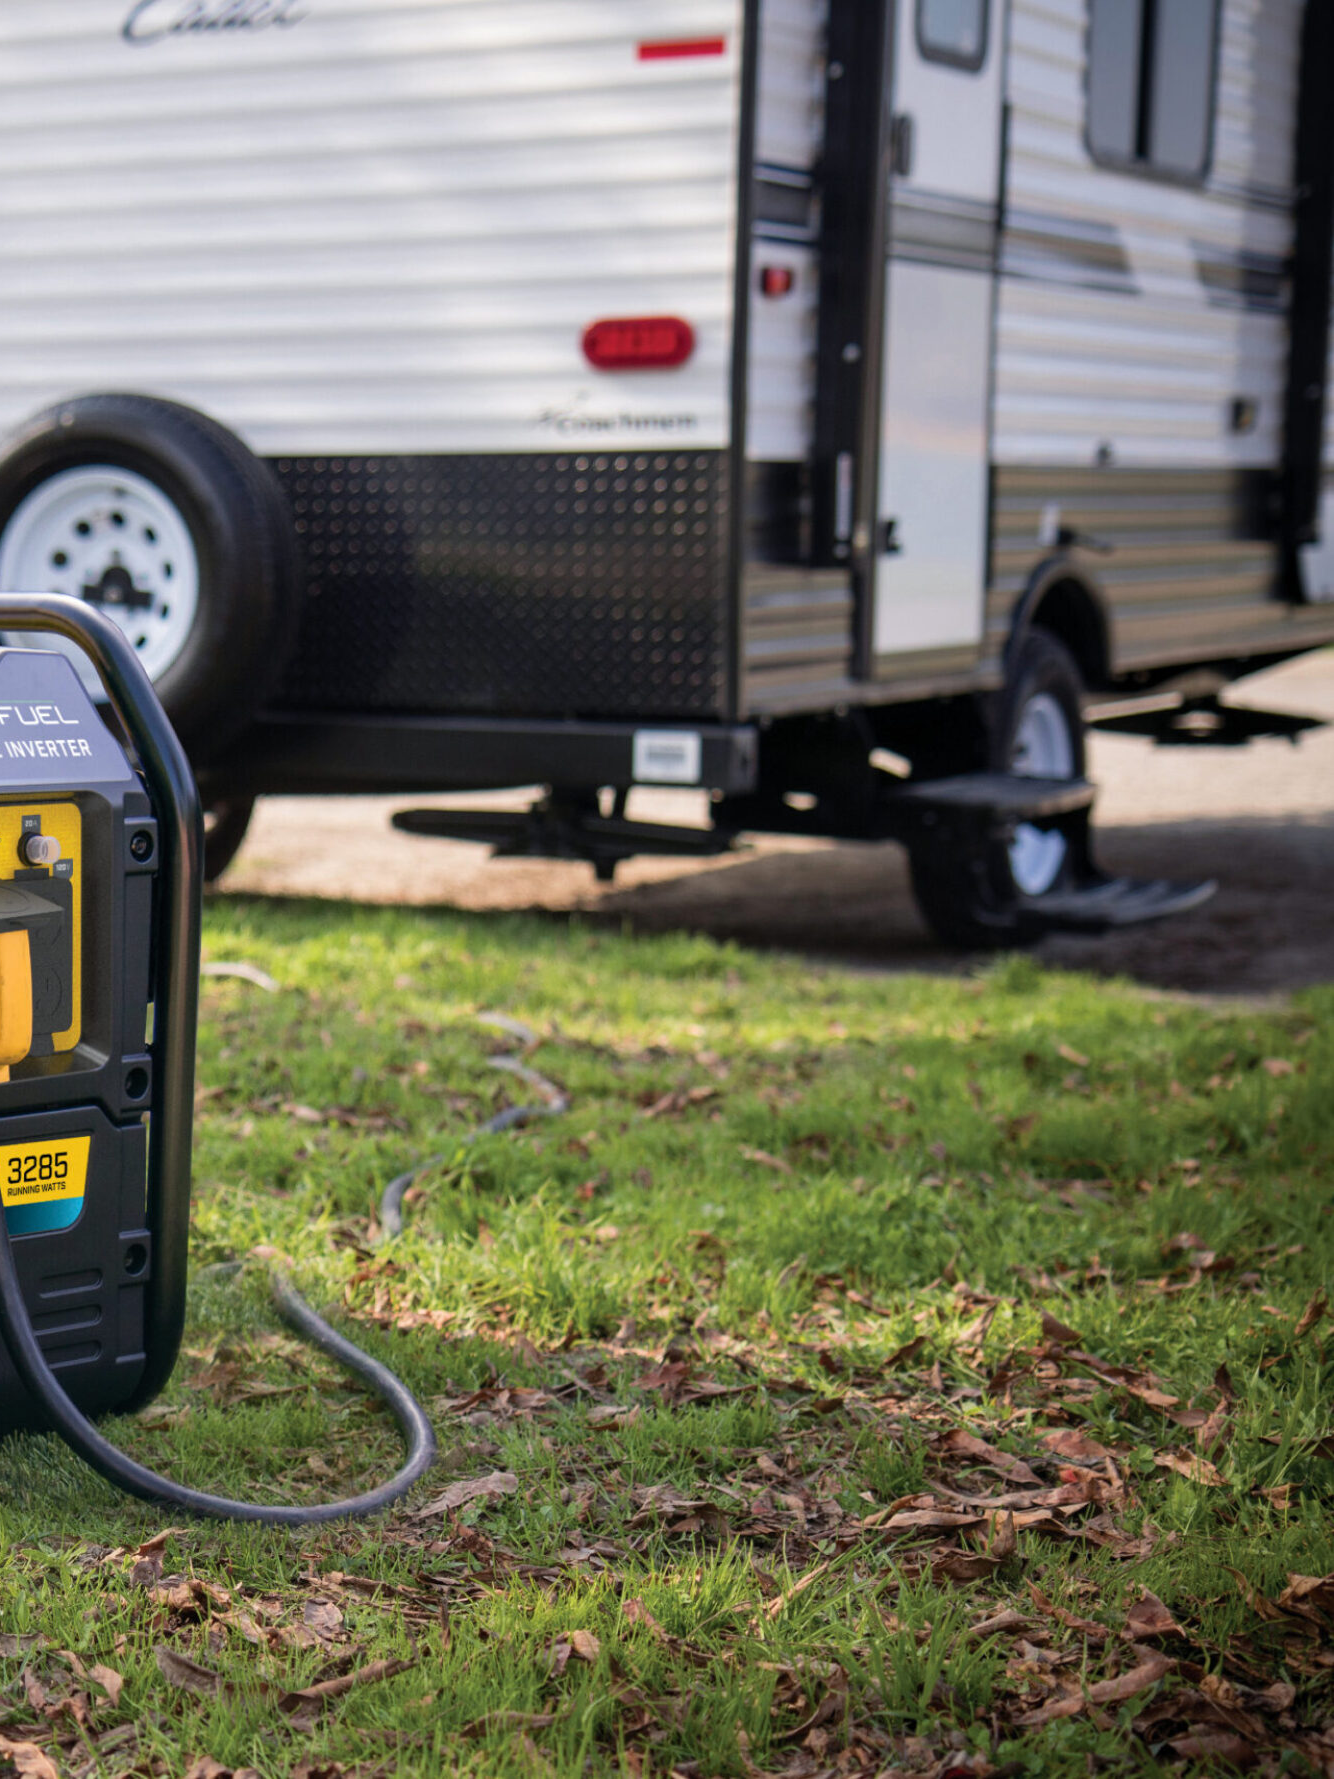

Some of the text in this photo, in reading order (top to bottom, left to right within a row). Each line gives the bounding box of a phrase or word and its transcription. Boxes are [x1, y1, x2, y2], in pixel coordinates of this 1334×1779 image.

[4, 738, 93, 758] INVERTER
[7, 1151, 68, 1184] 3285
[7, 1181, 66, 1197] RUNNING WATTS
